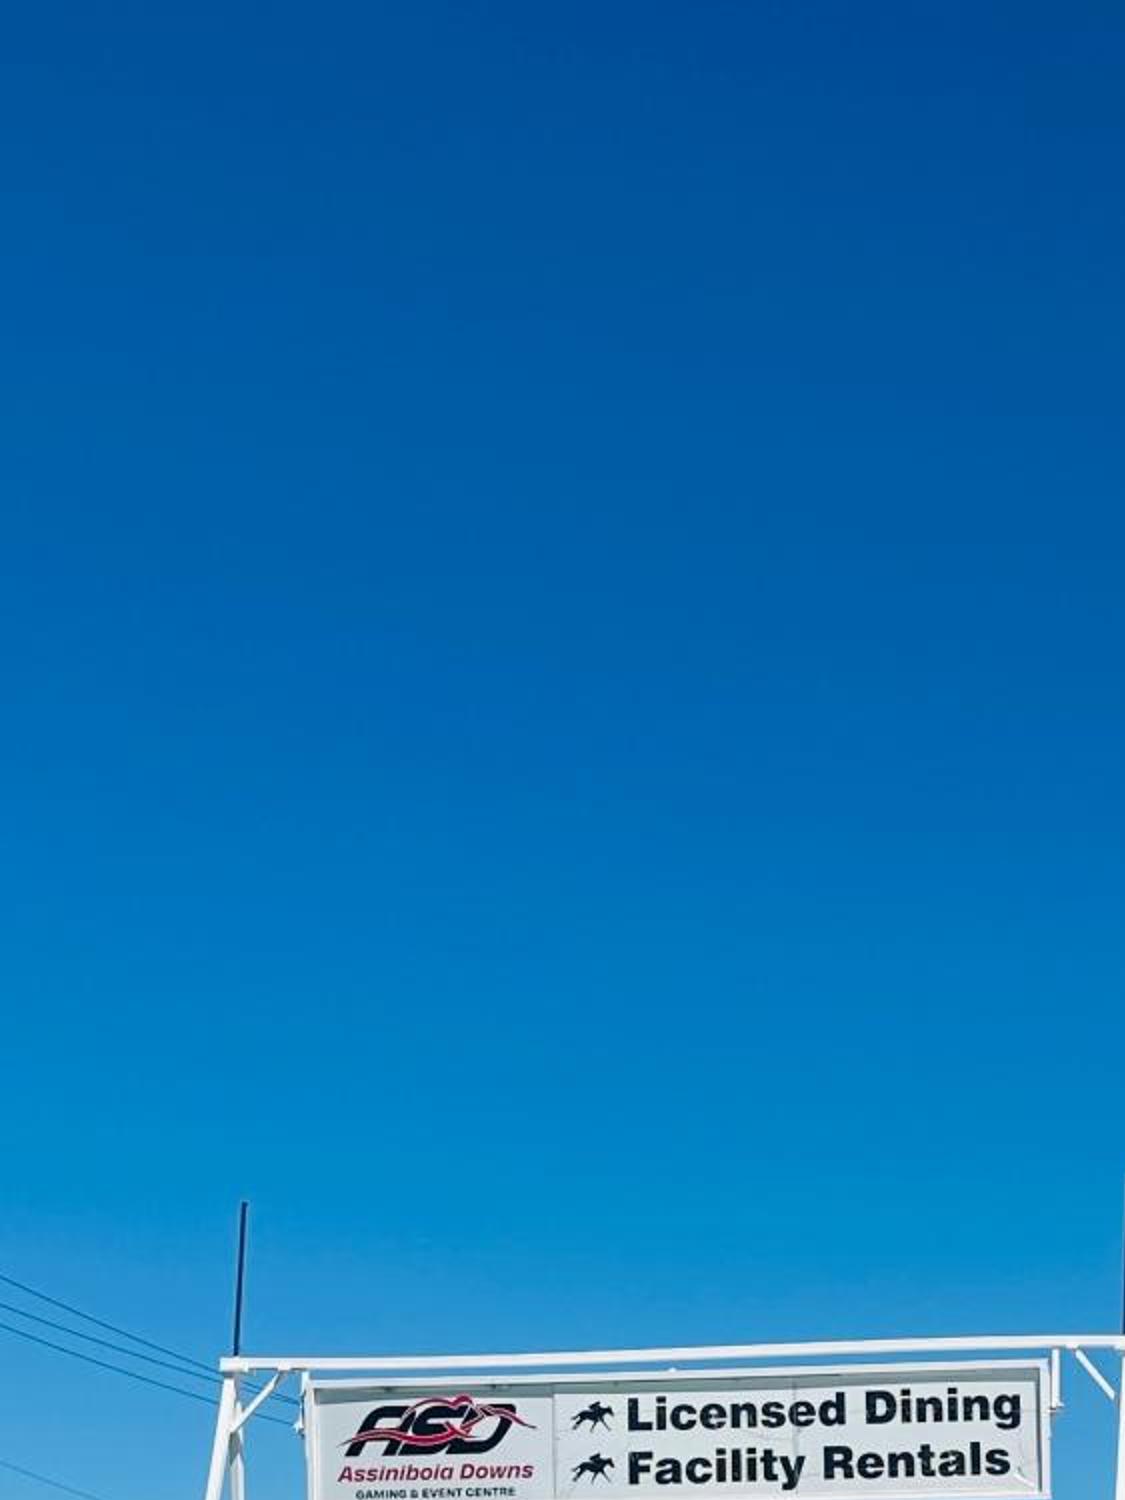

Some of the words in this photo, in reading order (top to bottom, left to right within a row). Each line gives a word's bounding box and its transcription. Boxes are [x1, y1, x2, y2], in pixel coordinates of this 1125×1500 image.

[626, 1391, 846, 1432] Licensed
[865, 1387, 1022, 1430] Dining
[337, 1463, 454, 1483] Assiniboia
[459, 1462, 534, 1481] Downs
[627, 1446, 806, 1491] Facility
[823, 1441, 1011, 1481] Rentals
[355, 1488, 407, 1500] GAMING
[410, 1488, 419, 1499] &
[421, 1487, 463, 1499] EVENT
[465, 1486, 517, 1498] CENTRE
